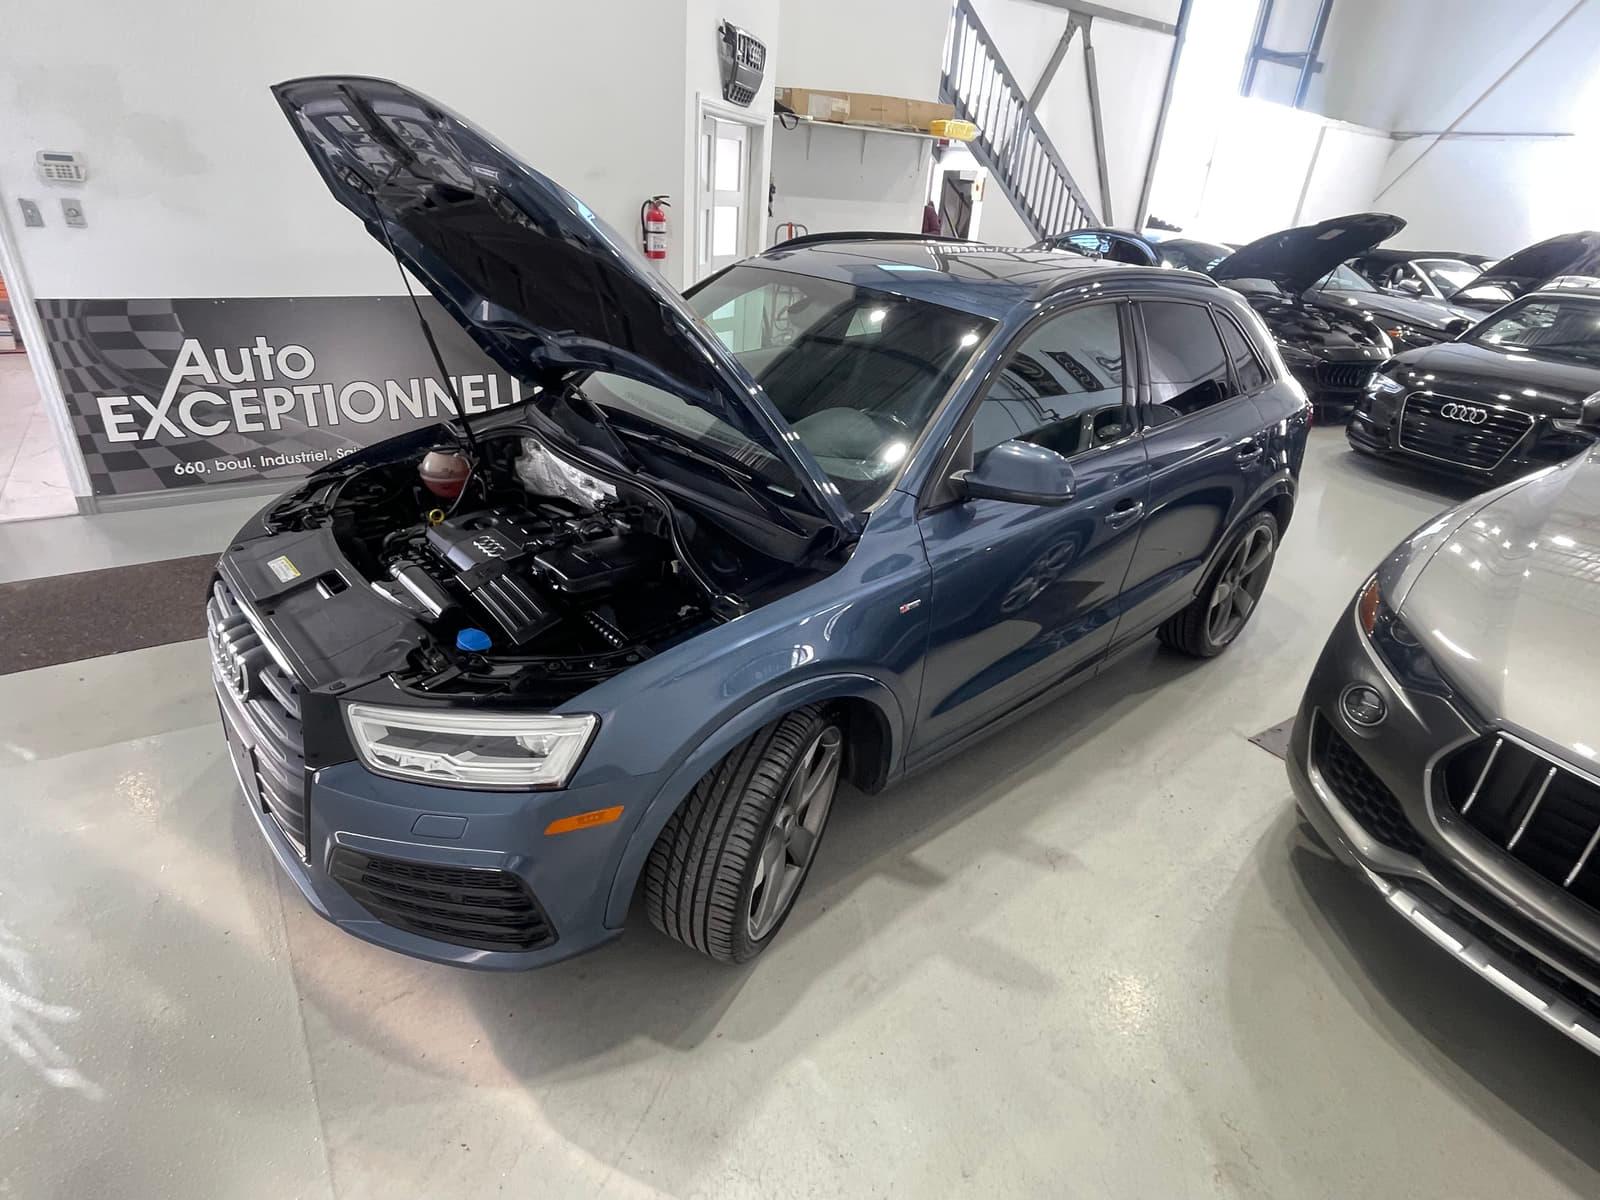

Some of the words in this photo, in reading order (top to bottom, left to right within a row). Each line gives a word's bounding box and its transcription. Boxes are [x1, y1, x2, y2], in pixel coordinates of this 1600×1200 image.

[166, 336, 315, 385] Auto
[96, 373, 543, 442] EXCEPTIONNELL
[174, 461, 211, 475] 660,
[215, 456, 255, 471] boul.
[260, 450, 332, 467] Industriel,
